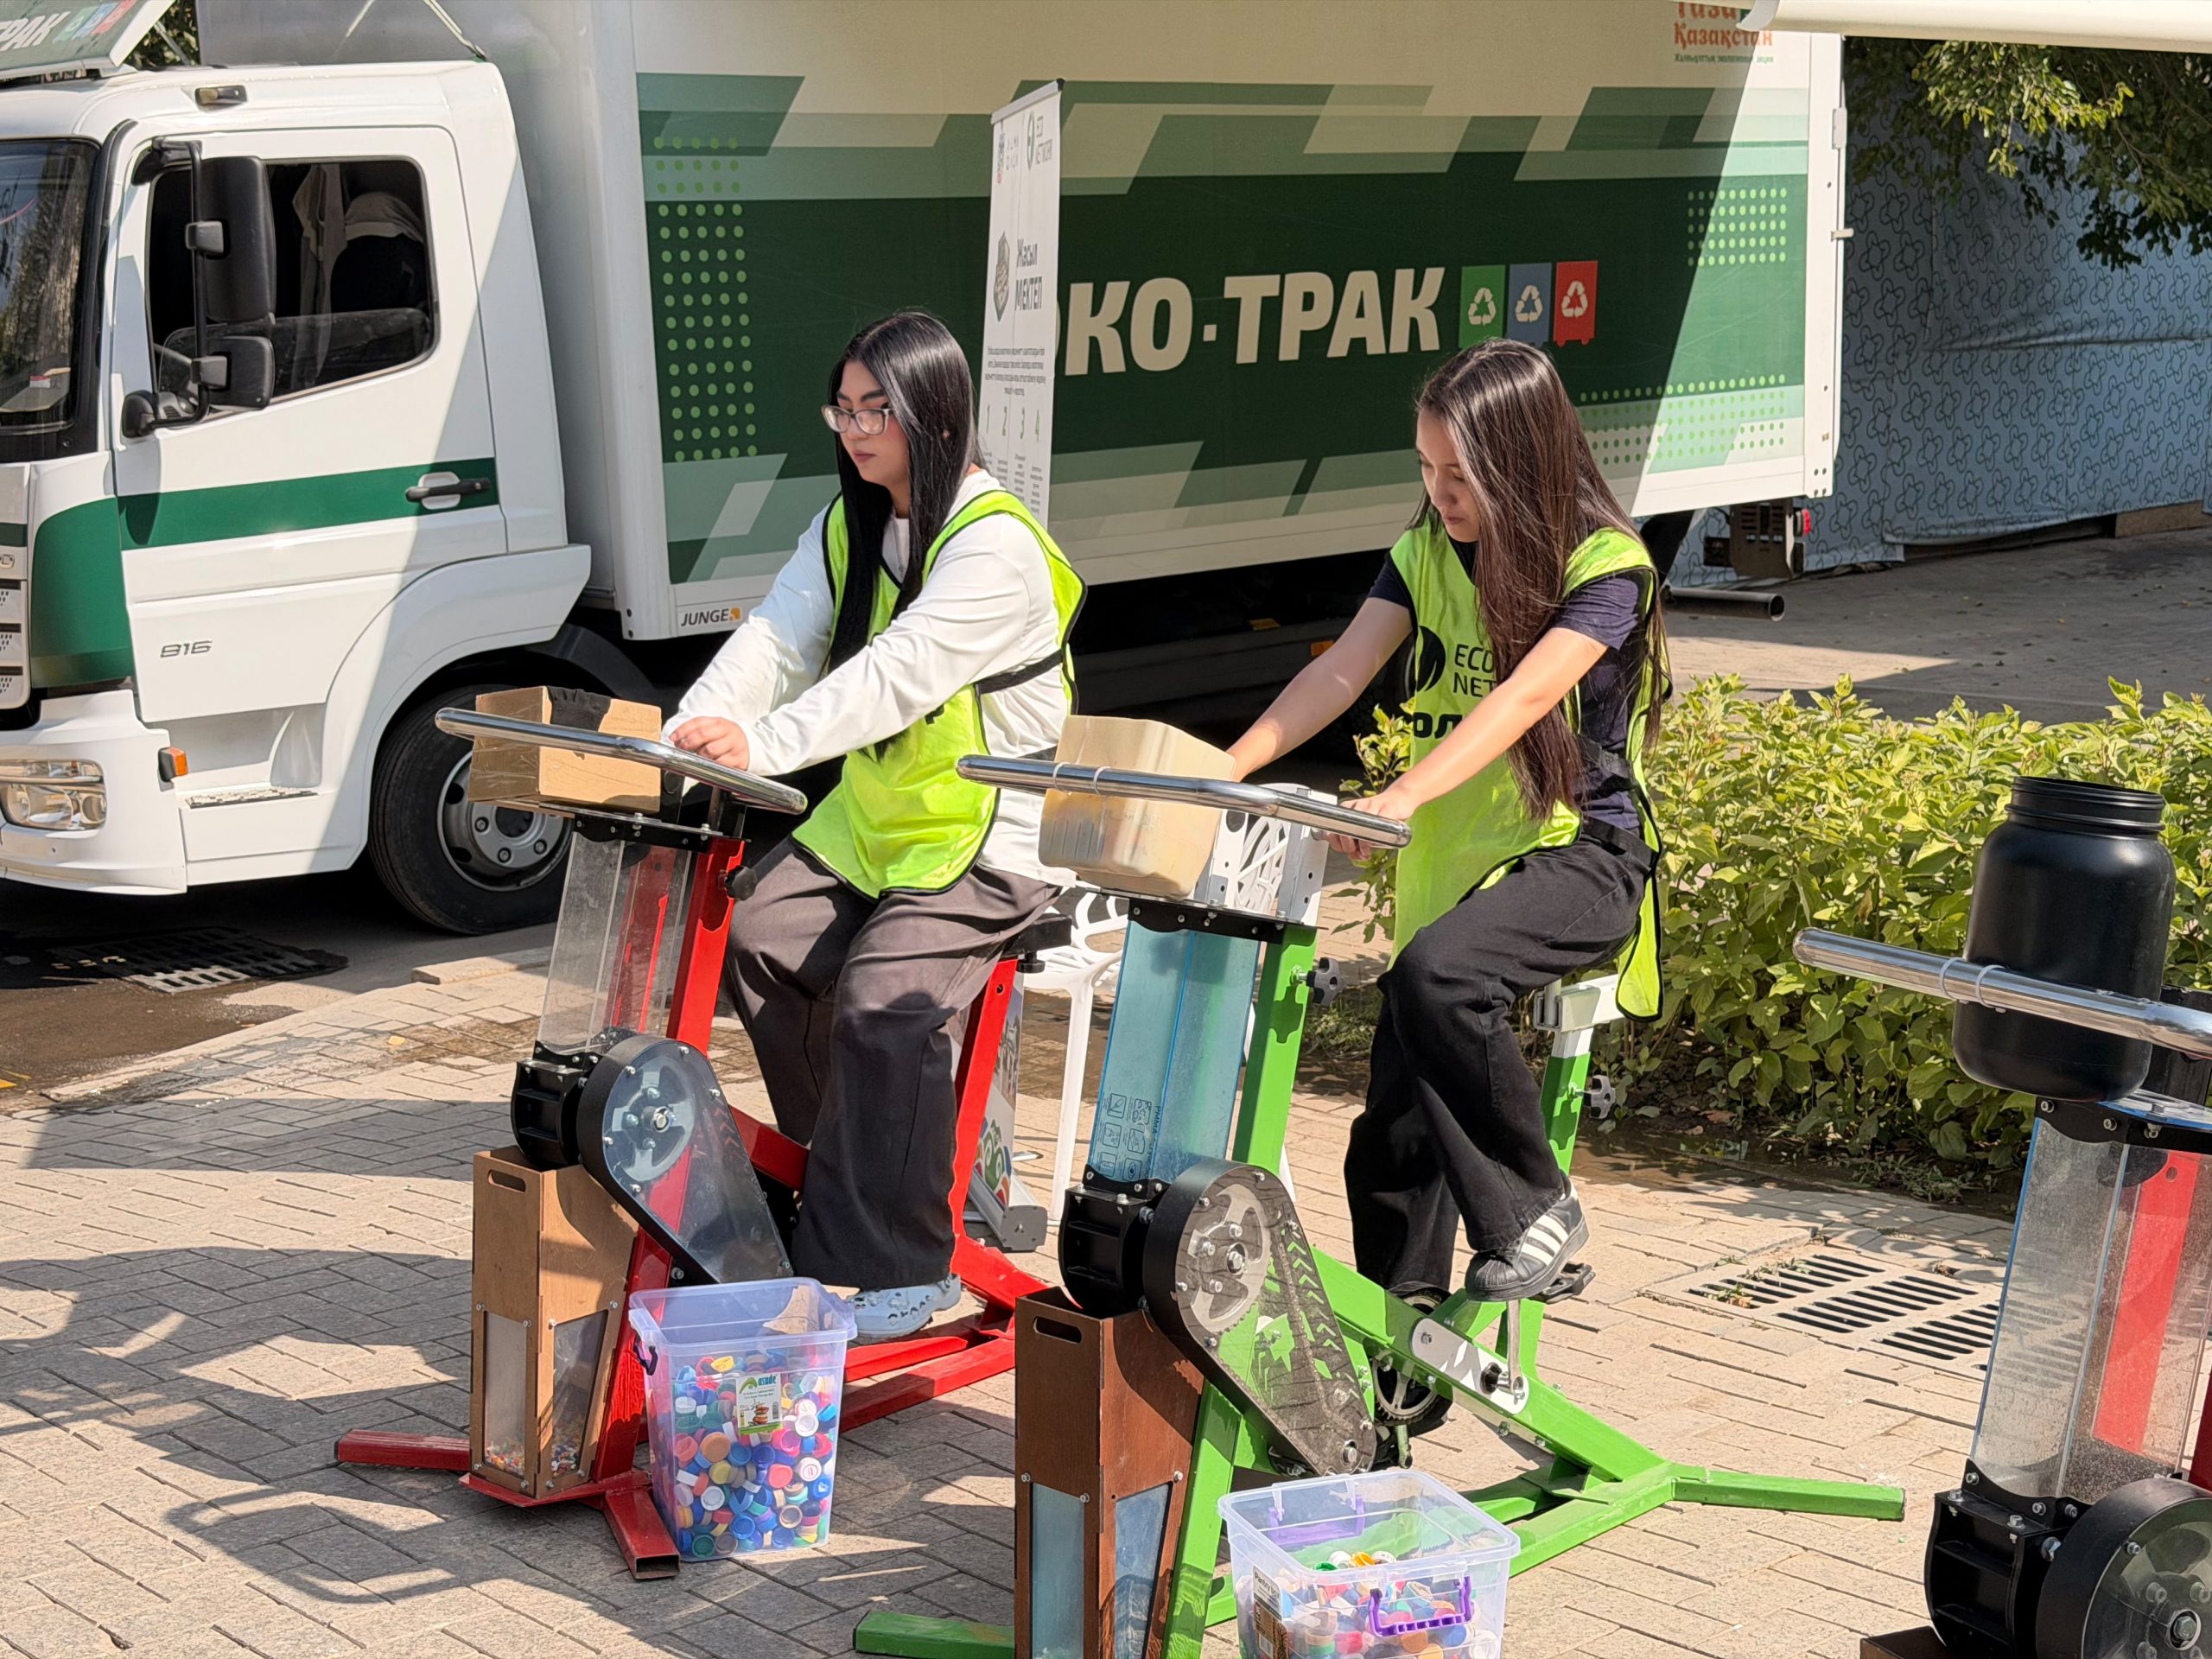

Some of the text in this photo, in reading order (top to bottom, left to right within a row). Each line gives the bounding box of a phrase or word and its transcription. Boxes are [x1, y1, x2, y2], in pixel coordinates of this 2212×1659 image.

[681, 608, 729, 627] JUNGE
[160, 639, 213, 658] 816
[758, 1373, 778, 1387] asude
